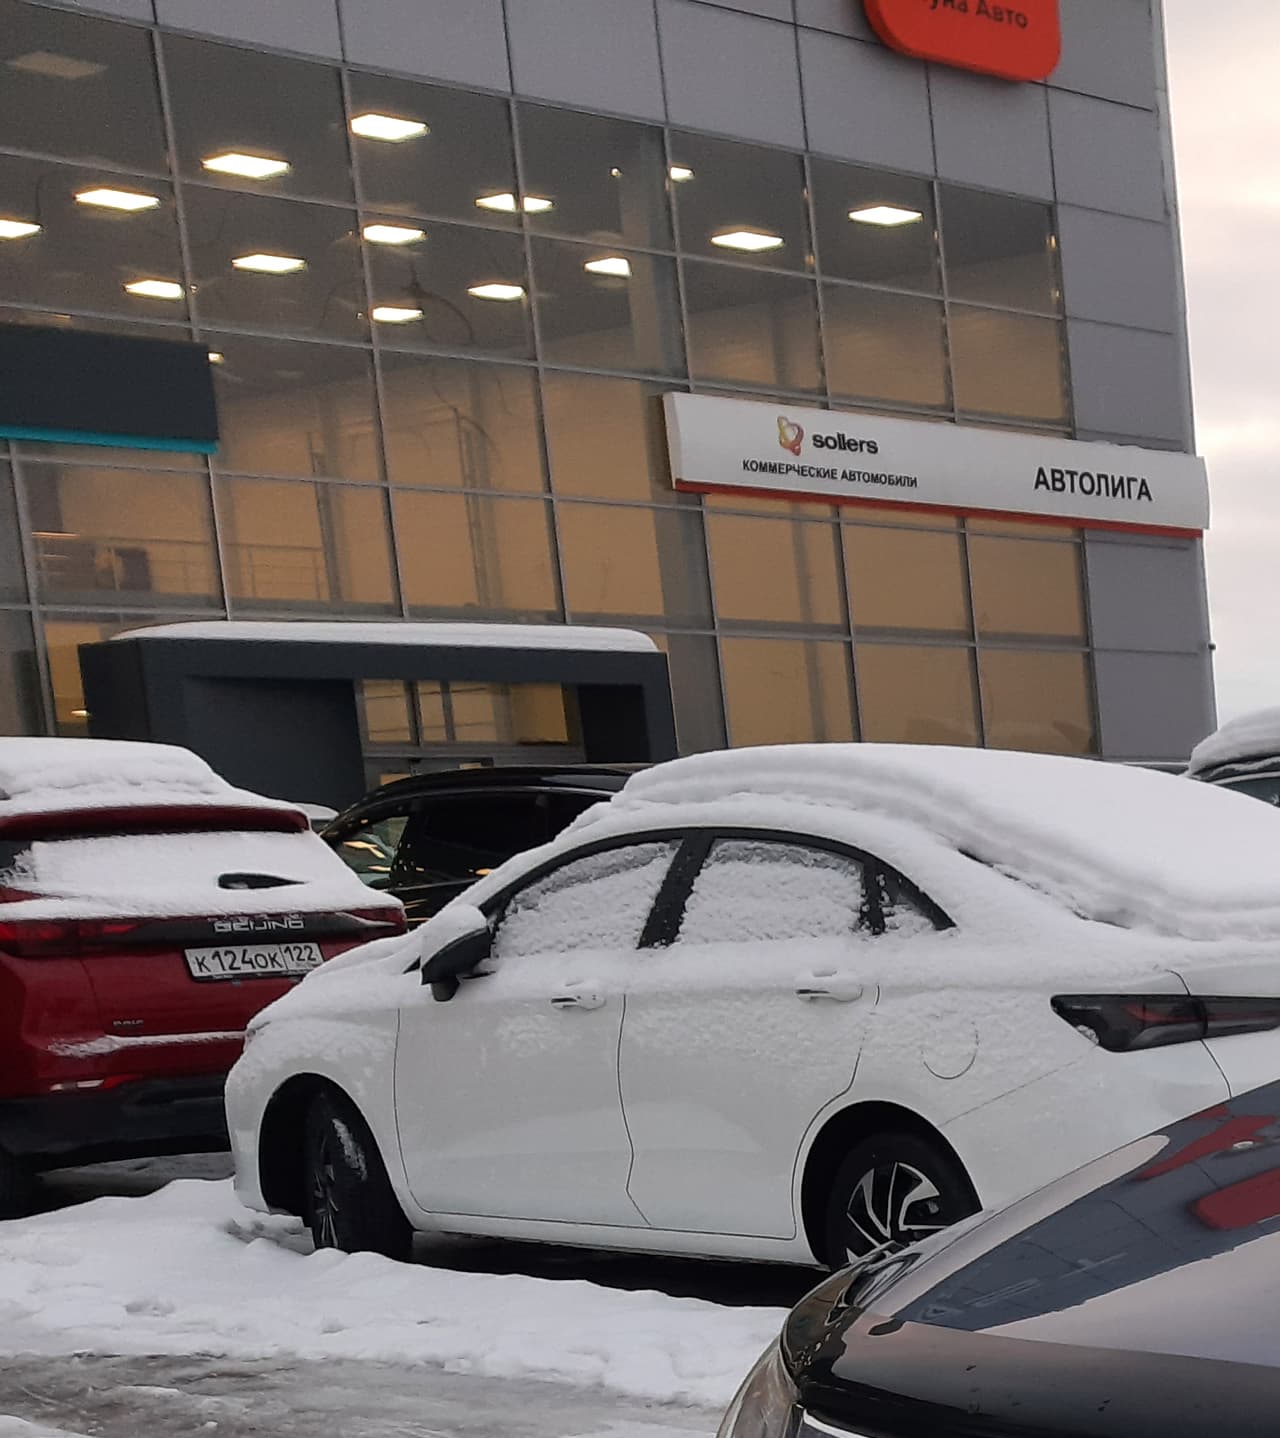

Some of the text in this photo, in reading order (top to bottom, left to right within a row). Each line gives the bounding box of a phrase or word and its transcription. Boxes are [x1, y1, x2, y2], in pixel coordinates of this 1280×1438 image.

[975, 0, 1029, 29] Авто
[811, 432, 879, 454] sollers
[742, 459, 918, 488] КОММЕРЧЕСКИЕ АВТОМОБИЛИ
[1033, 466, 1154, 501] АВТОЛИГА
[284, 945, 317, 962] 122
